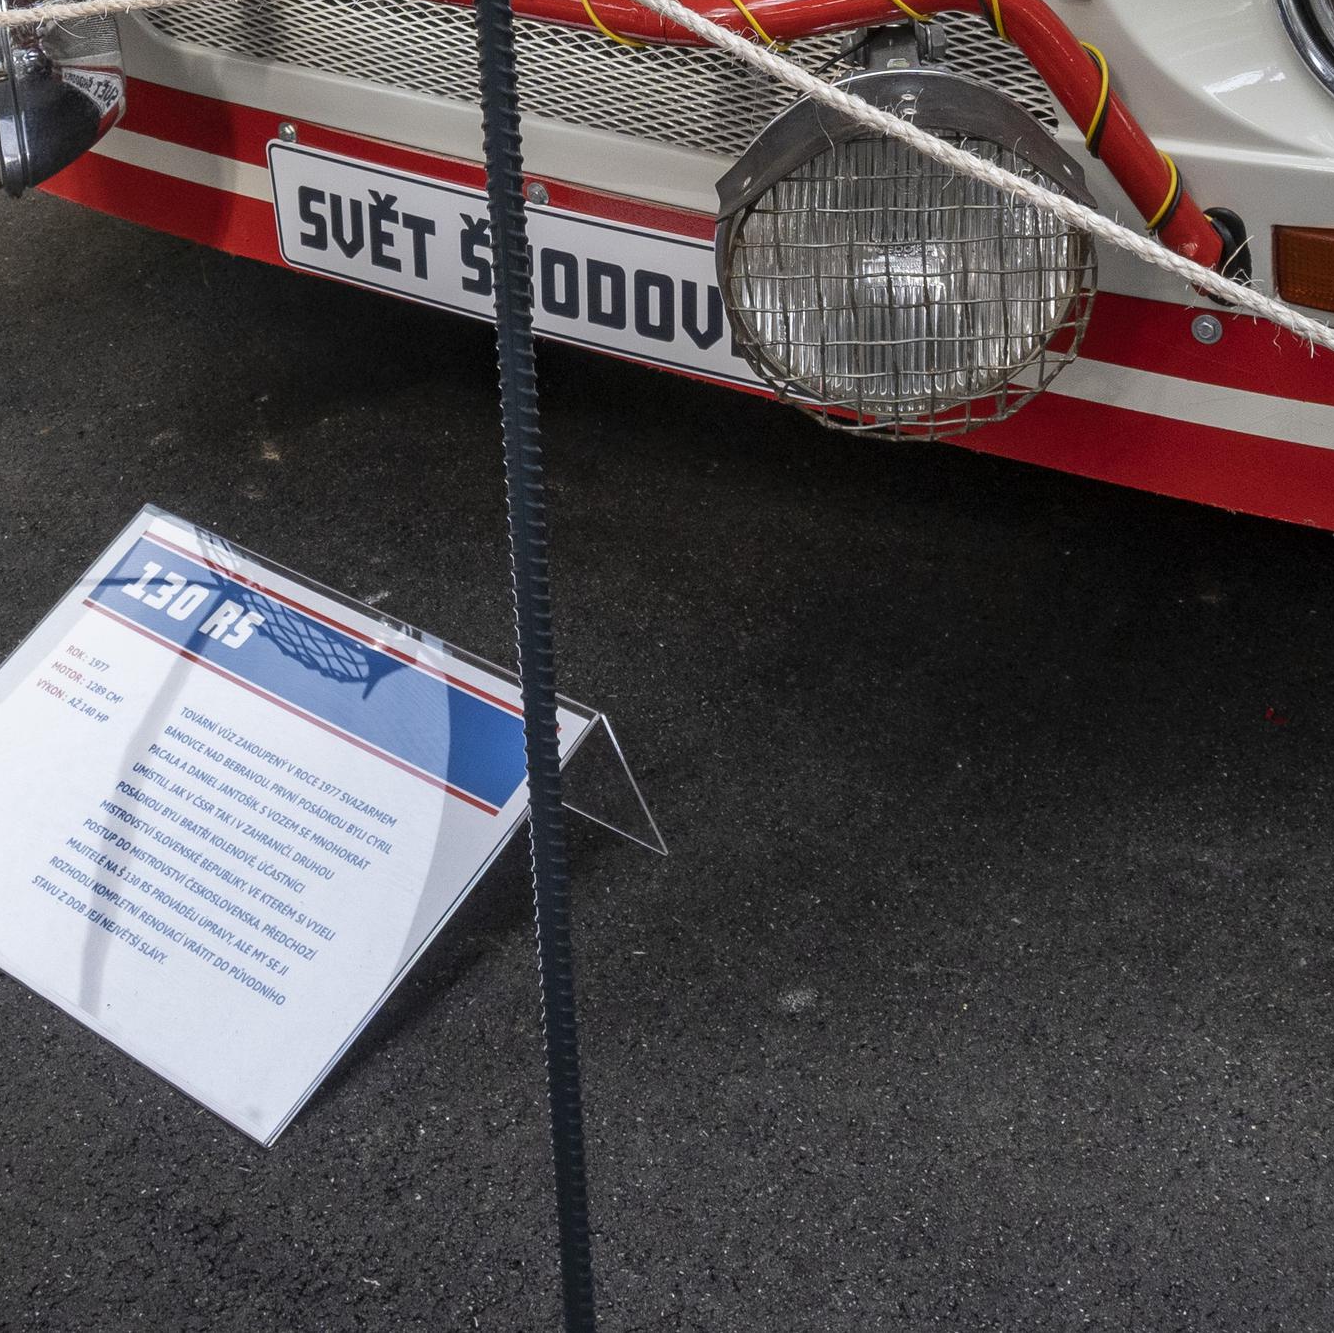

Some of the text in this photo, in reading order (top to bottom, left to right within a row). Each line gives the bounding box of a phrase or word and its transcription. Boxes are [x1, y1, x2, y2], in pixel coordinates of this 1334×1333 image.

[297, 184, 436, 281] SVĚT
[121, 561, 265, 651] 130 RS
[66, 694, 84, 708] AŽ
[78, 703, 97, 716] 140
[93, 711, 110, 724] HP
[85, 680, 108, 696] 1289
[87, 657, 110, 672] 1977
[146, 742, 181, 767] PACALA
[185, 764, 219, 789] DANIEL
[265, 807, 301, 833] VOZEM
[296, 825, 313, 840] SE
[308, 832, 371, 870] MNOHOKRÁT
[179, 705, 220, 733] TOVÁRNÍ
[215, 725, 238, 743] VŮZ
[233, 735, 289, 769] ZAKOUPENÝ
[292, 766, 321, 787] ROCE
[316, 780, 343, 797] 1977
[338, 791, 398, 828] SVAZARMEM
[201, 745, 225, 763] NAD
[268, 782, 301, 804] PRVNÍ
[295, 796, 348, 830] POSÁDKOU
[344, 822, 368, 841] BYLI
[364, 833, 393, 855] CYRIL
[98, 798, 157, 836] MISTROVSTVÍ
[151, 829, 203, 864] SLOVENSKÉ
[246, 883, 263, 899] VE
[258, 891, 298, 920] KTERÉM
[293, 912, 308, 926] SI
[304, 917, 337, 942] VYJELI
[114, 779, 163, 812] POSÁDKOU
[159, 805, 183, 823] BYLI
[178, 816, 213, 840] BRATŘI
[255, 859, 306, 894] ÚČASTNÍCI
[166, 782, 188, 799] JAK
[190, 793, 216, 815] ČSSR
[212, 806, 233, 824] TAK
[290, 851, 335, 881] DRUHOU
[30, 874, 61, 897] STAVU
[63, 894, 87, 914] DOB
[82, 907, 106, 924] JEJÍ
[98, 916, 143, 948] NEJVĚTŠÍ
[48, 855, 286, 1006] ROZHODLI KOMPLETNÍ RENOVACÍ VRÁTIT DO PŮVODNÍHO
[81, 817, 119, 842] POSTUP
[113, 835, 132, 852] DO
[128, 845, 188, 884] MISTROVSTVÍ
[260, 922, 319, 961] PŘEDCHOZÍ
[101, 858, 119, 875] NA
[121, 870, 142, 887] 130
[137, 879, 154, 894] RS
[149, 886, 200, 922] PROVÁDĚLI
[231, 937, 254, 955] ALE
[249, 947, 270, 964] MY
[264, 956, 281, 972] SE
[275, 963, 290, 977] JI
